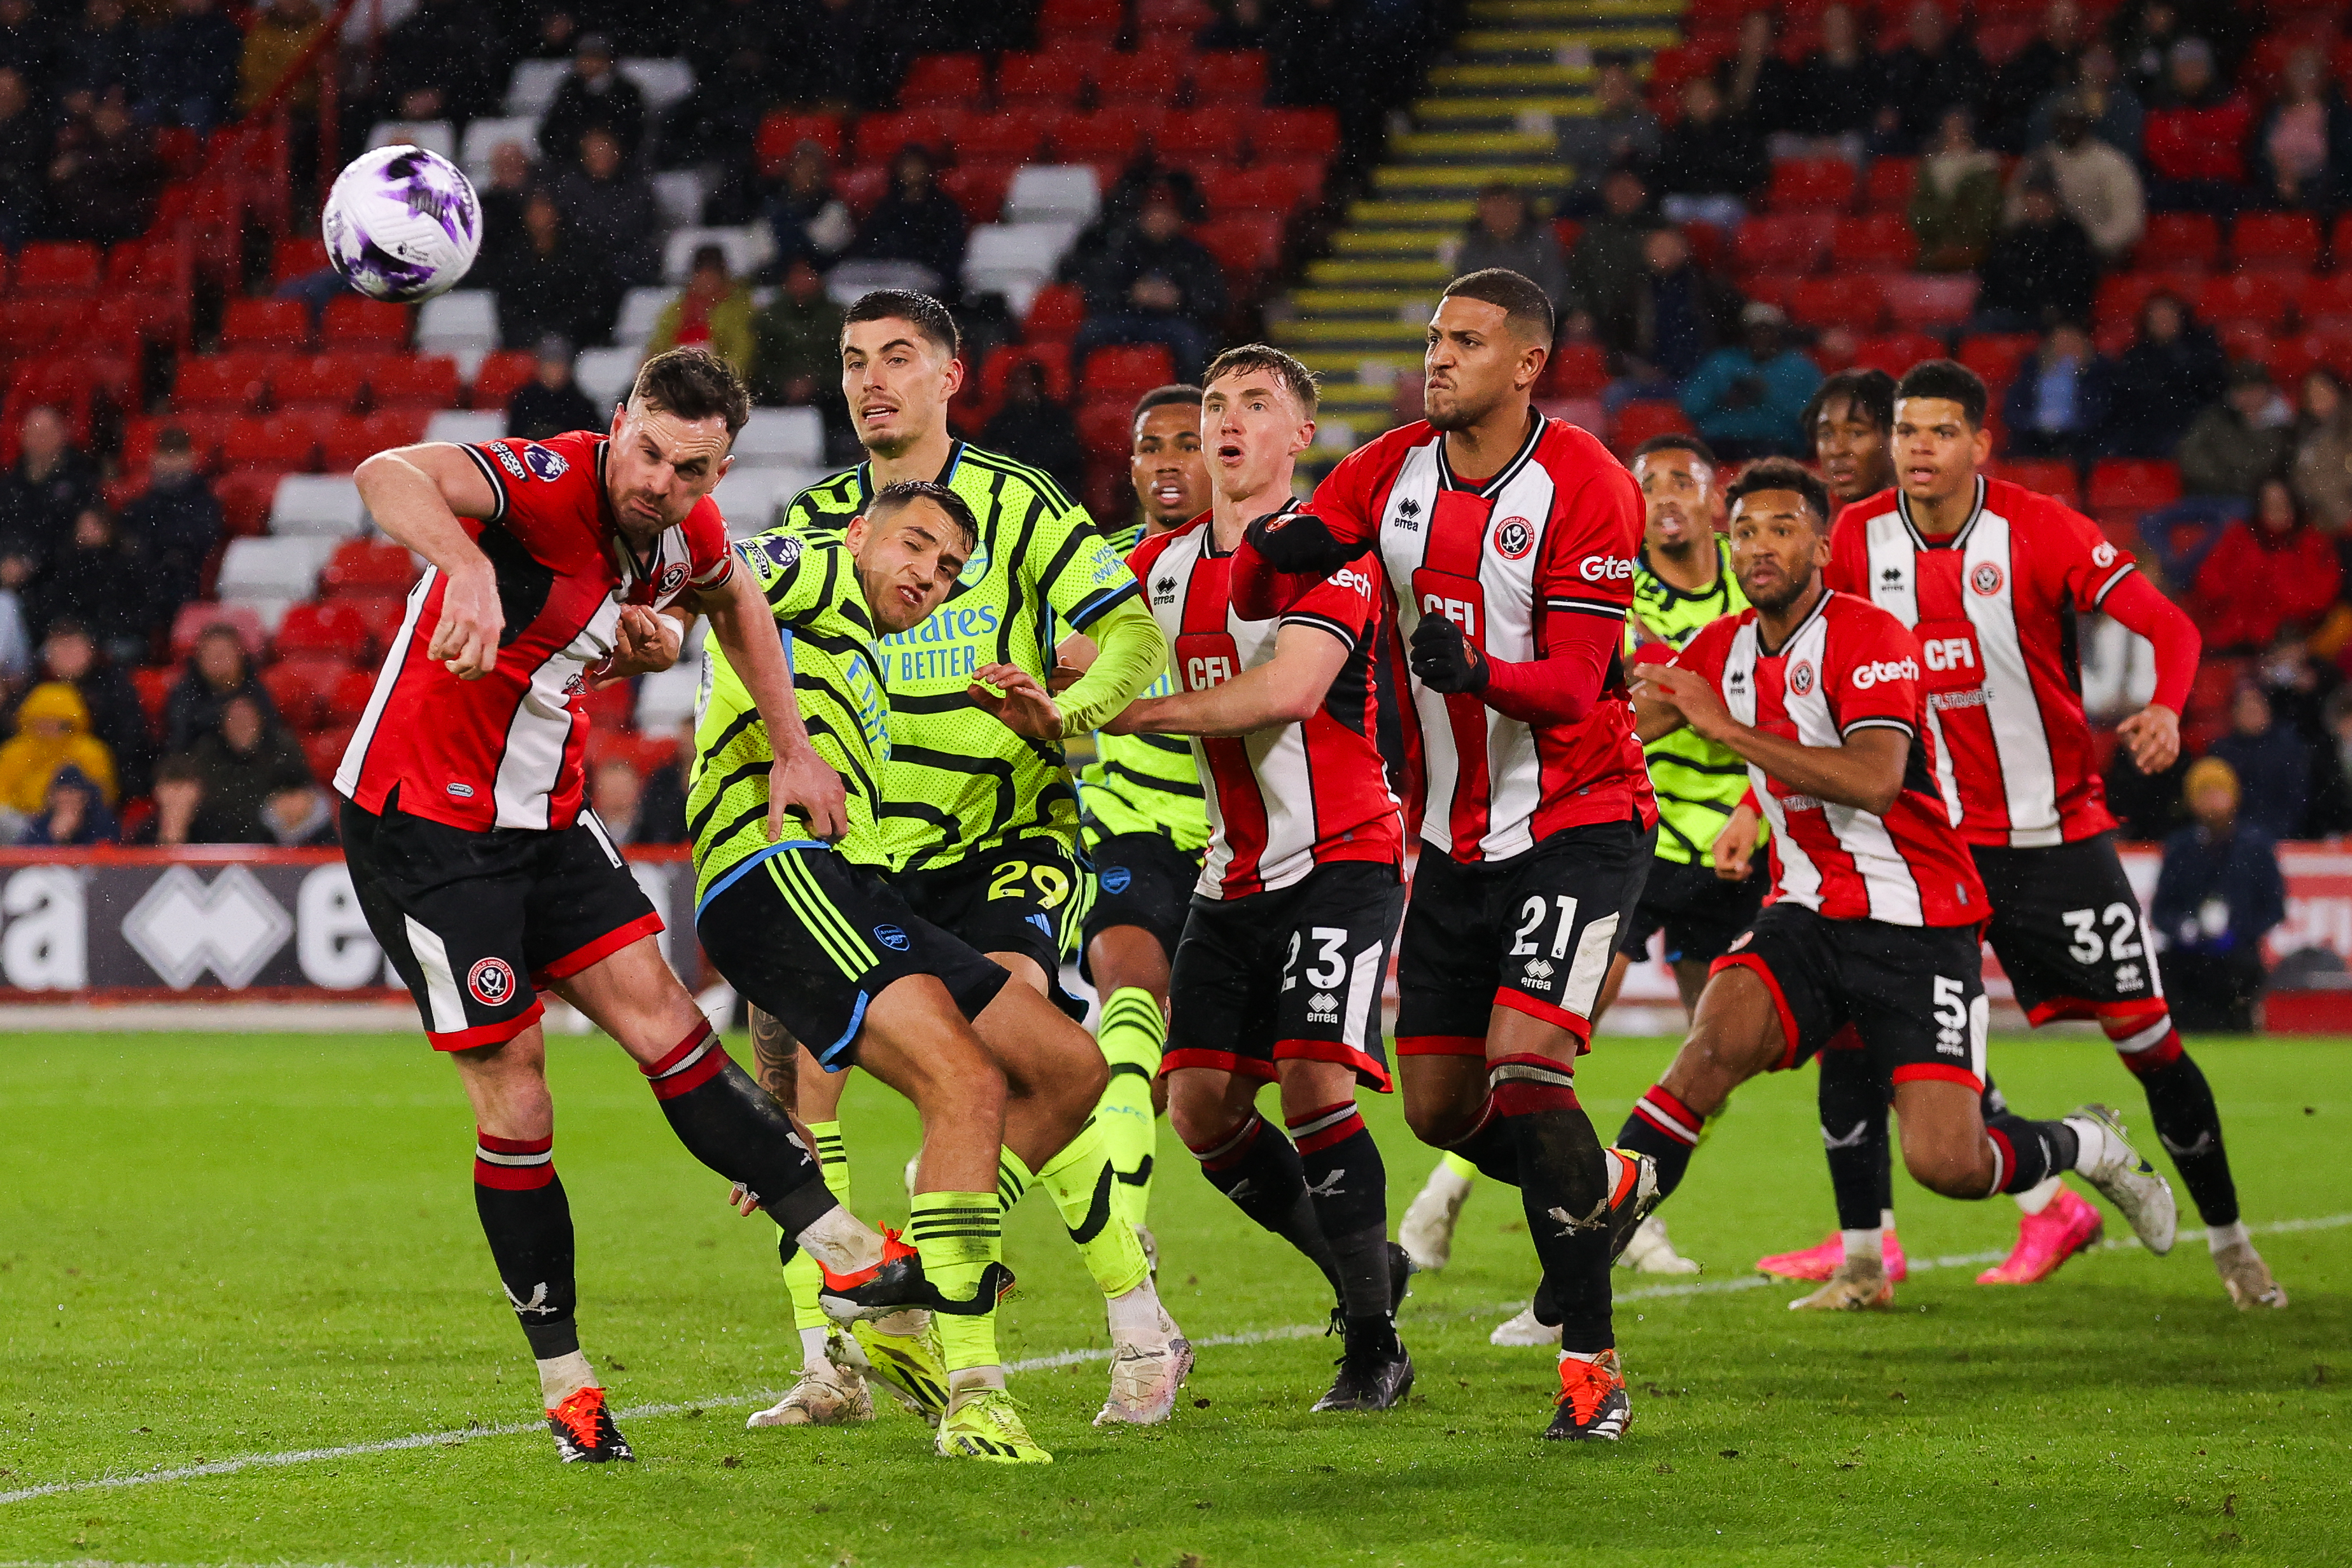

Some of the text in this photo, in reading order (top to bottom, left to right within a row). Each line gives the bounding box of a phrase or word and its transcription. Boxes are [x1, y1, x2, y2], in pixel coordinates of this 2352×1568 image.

[505, 451, 526, 479] room
[1394, 517, 1419, 532] errea
[753, 548, 769, 574] room
[1153, 594, 1175, 606] errea
[902, 645, 976, 682] BETTER
[1923, 637, 1975, 671] CFI
[1187, 655, 1233, 692] CFI
[1852, 655, 1920, 690] Gtech
[577, 808, 623, 869] 1
[987, 860, 1069, 910] 29
[1509, 895, 1578, 960] 21
[2061, 902, 2143, 965] 32
[1280, 927, 1348, 994] 23
[1521, 977, 1551, 991] errea
[1933, 974, 1968, 1030] 5
[1306, 1012, 1338, 1024] errea
